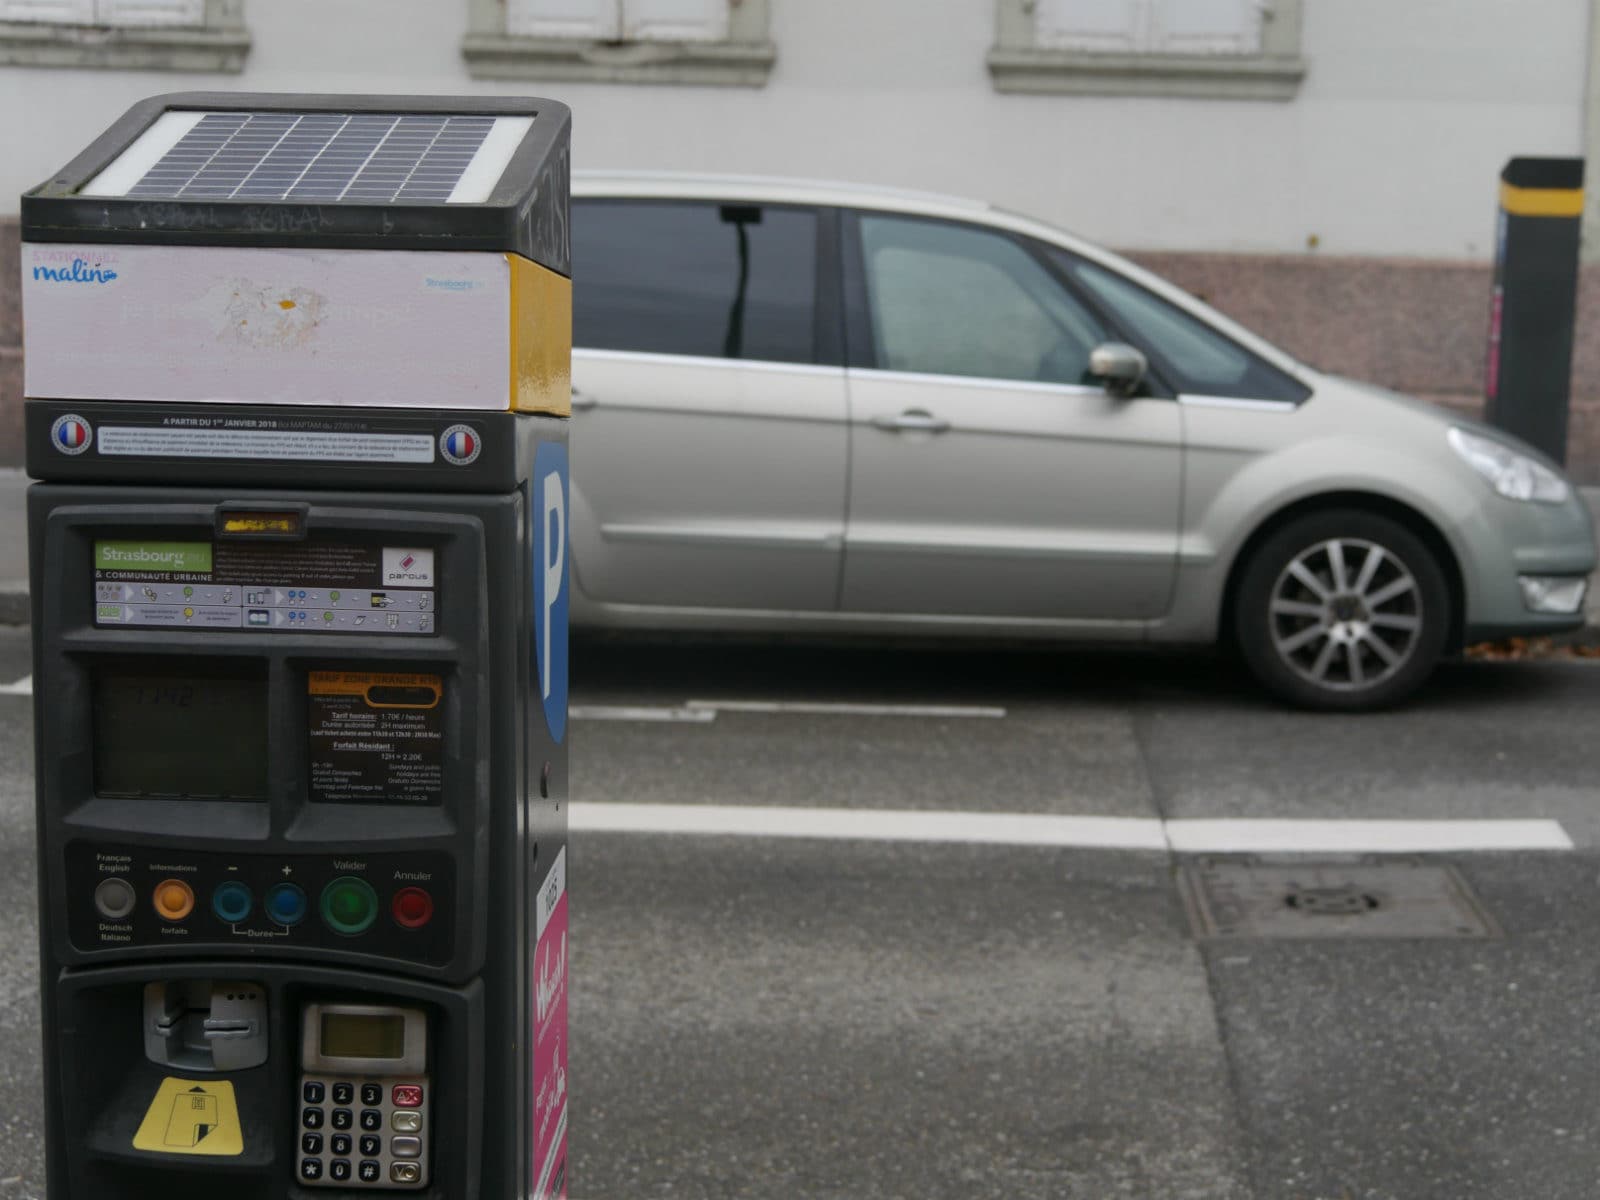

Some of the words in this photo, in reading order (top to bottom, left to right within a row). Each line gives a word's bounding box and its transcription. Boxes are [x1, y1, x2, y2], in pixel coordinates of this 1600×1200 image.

[33, 258, 109, 283] malin
[163, 417, 169, 425] A
[171, 418, 198, 426] PARTIR
[199, 418, 211, 426] DU
[224, 419, 257, 427] JANVIER
[258, 420, 277, 428] 2018
[103, 547, 184, 568] Strasbourg
[95, 570, 102, 578] &
[173, 572, 212, 582] URBAINE
[389, 572, 428, 581] parcus
[544, 471, 564, 701] P
[99, 863, 130, 873] English
[333, 860, 367, 872] Valider
[394, 869, 432, 882] Annuler
[98, 923, 133, 933] Deutsch
[100, 933, 131, 942] Italiano
[338, 1089, 347, 1099] 2
[367, 1090, 374, 1101] 3
[308, 1114, 316, 1124] 4
[337, 1114, 345, 1125] 5
[366, 1115, 373, 1126] 6
[308, 1139, 315, 1149] 7
[337, 1140, 344, 1150] 8
[366, 1140, 373, 1151] 9
[336, 1165, 343, 1175] 0
